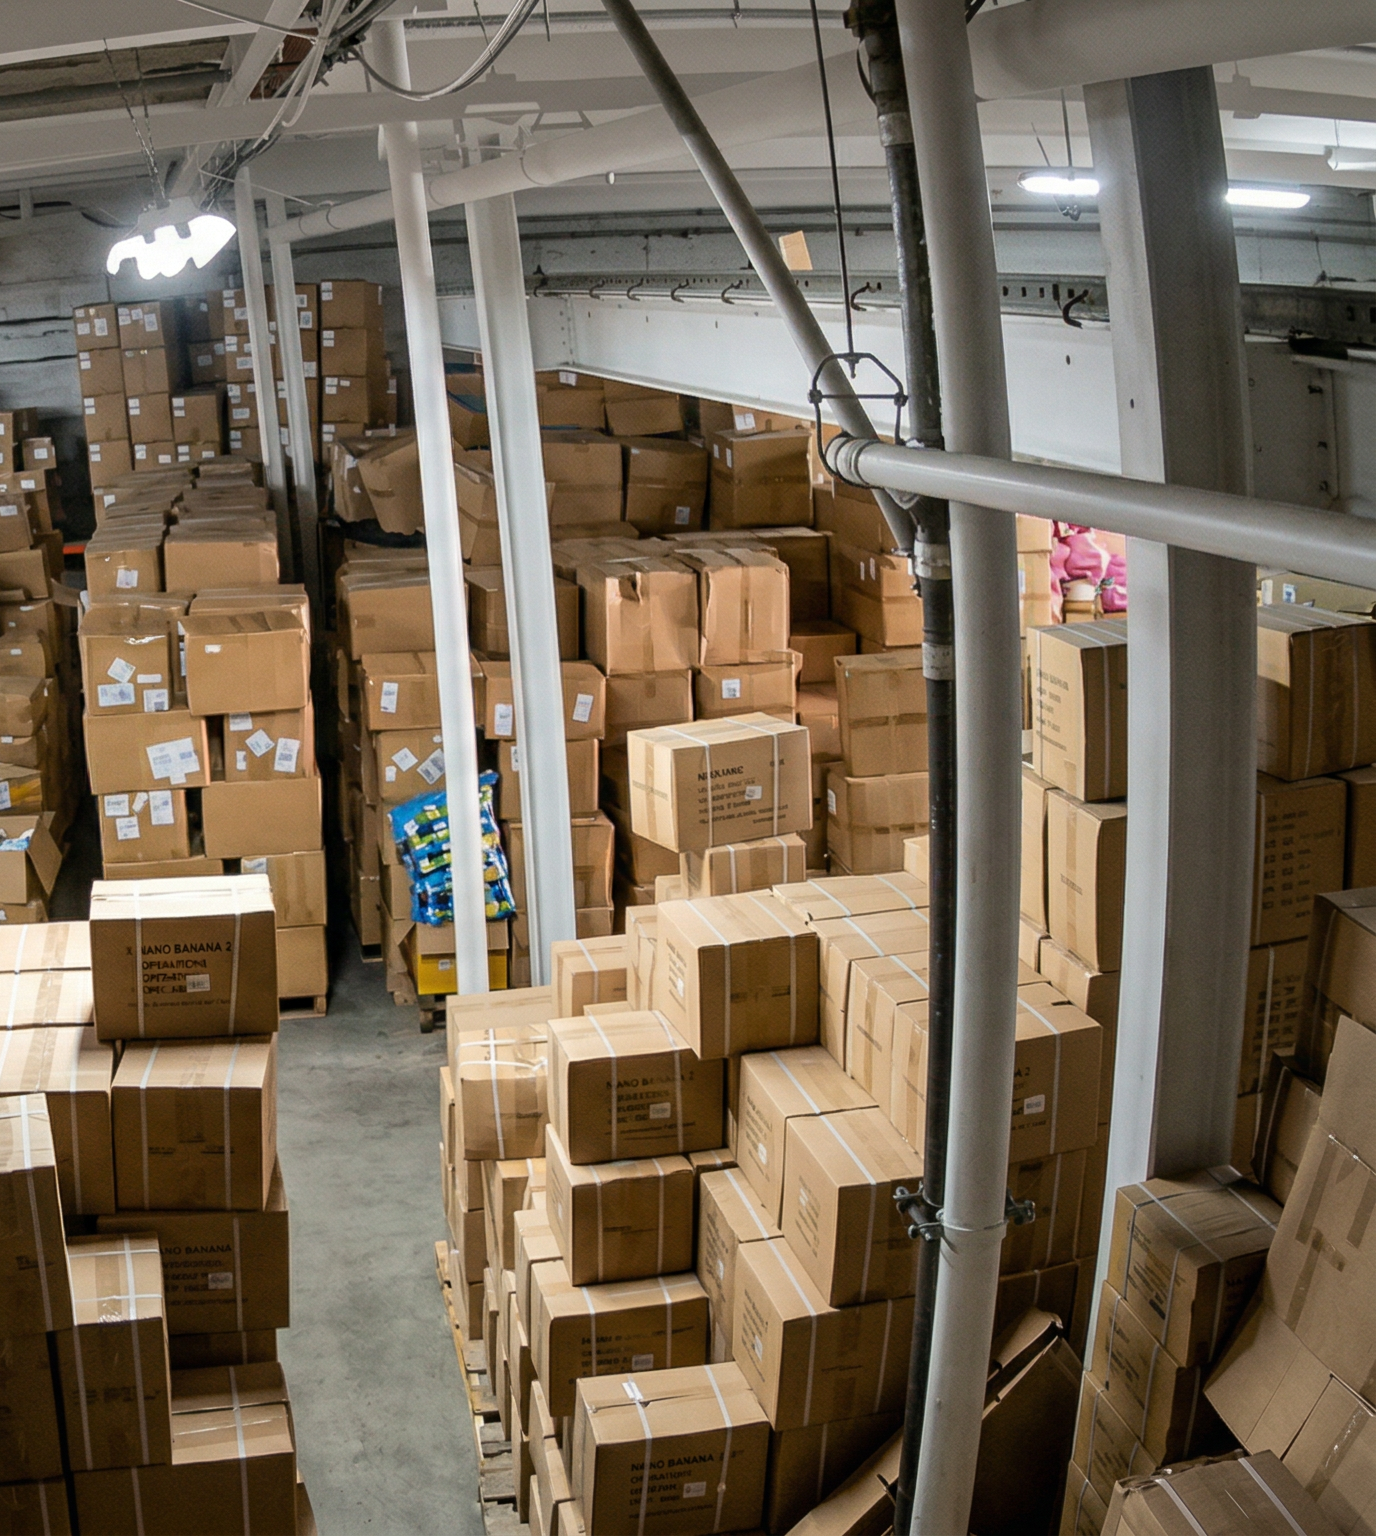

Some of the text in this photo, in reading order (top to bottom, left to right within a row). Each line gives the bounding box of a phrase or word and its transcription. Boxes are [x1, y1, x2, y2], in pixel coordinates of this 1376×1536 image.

[174, 942, 222, 954] BANANA
[225, 941, 232, 952] 2
[668, 1453, 714, 1468] BANANA
